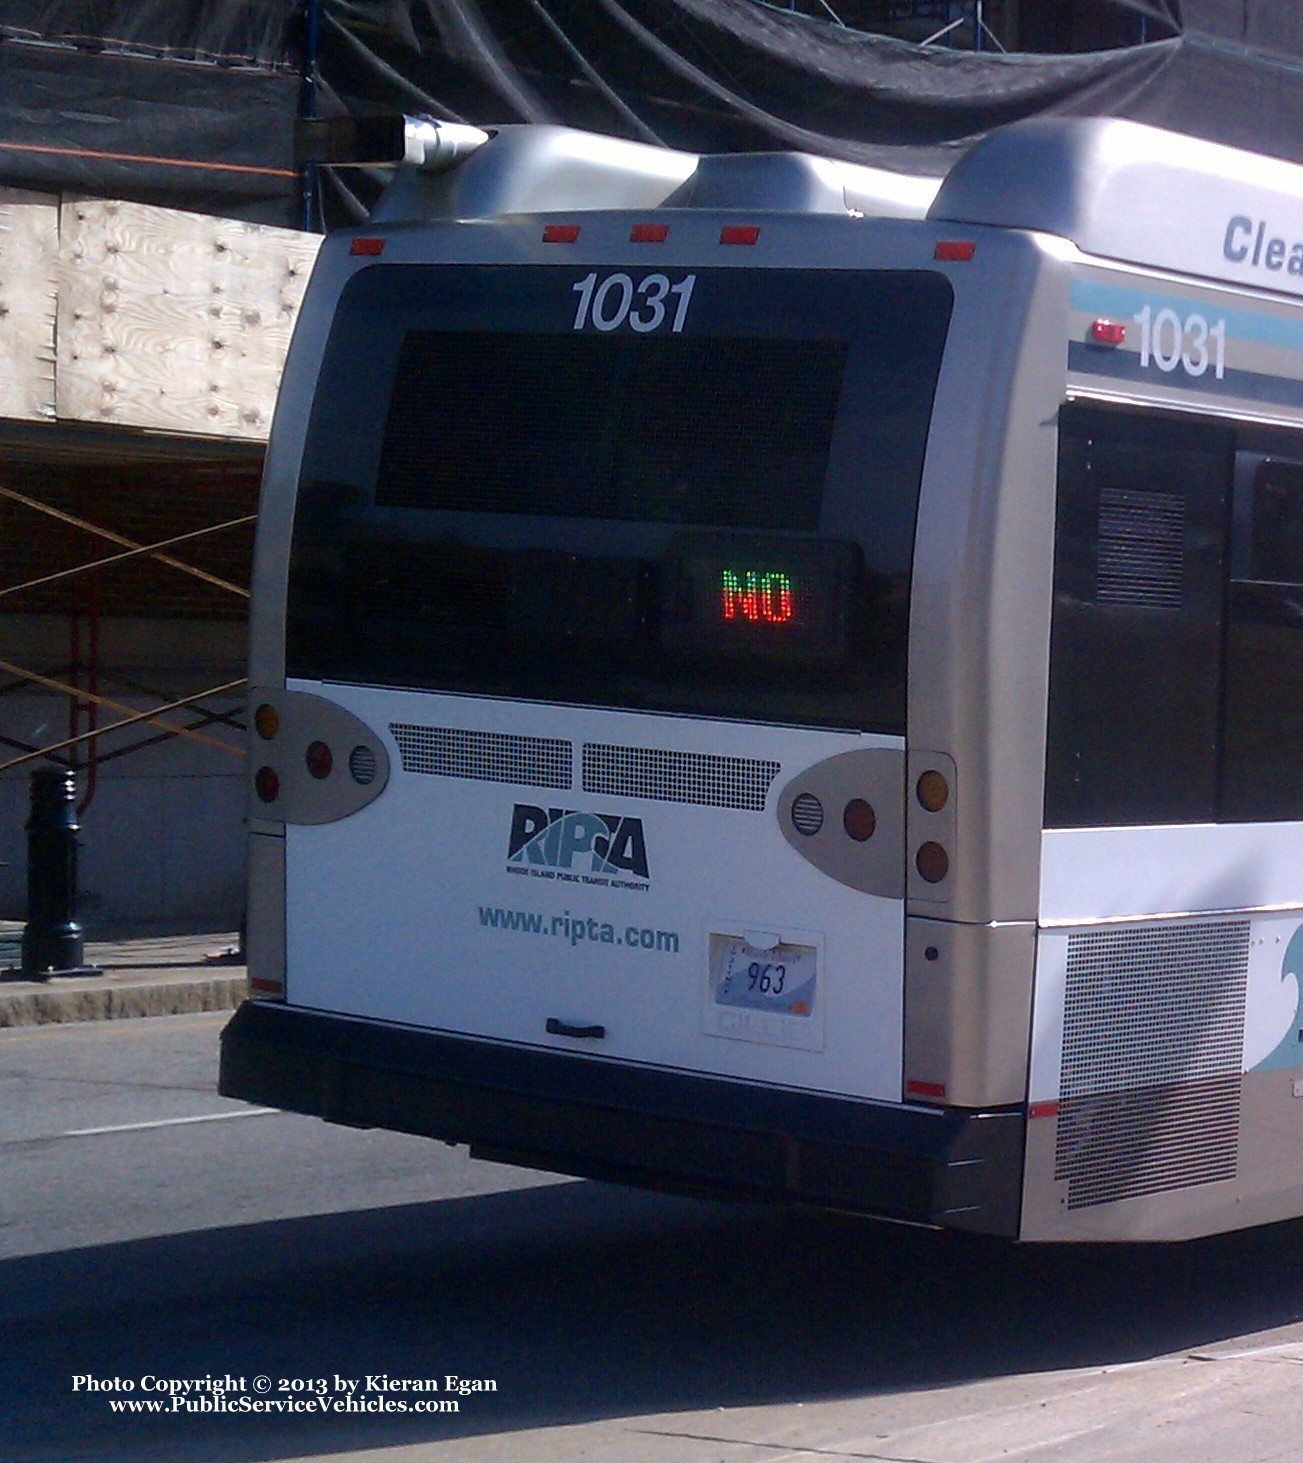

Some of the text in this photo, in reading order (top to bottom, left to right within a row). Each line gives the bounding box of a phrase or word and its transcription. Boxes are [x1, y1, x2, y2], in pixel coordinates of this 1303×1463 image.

[573, 273, 696, 332] 1031
[1134, 304, 1226, 380] 1031
[723, 569, 791, 622] NO
[507, 803, 650, 879] RIPTA
[530, 869, 555, 880] ISLAND
[556, 872, 580, 883] PUBLIC
[581, 875, 609, 887] TRANSIT
[610, 880, 650, 892] AUTHORITY
[478, 906, 680, 953] www.ripta.com
[748, 962, 786, 994] 963
